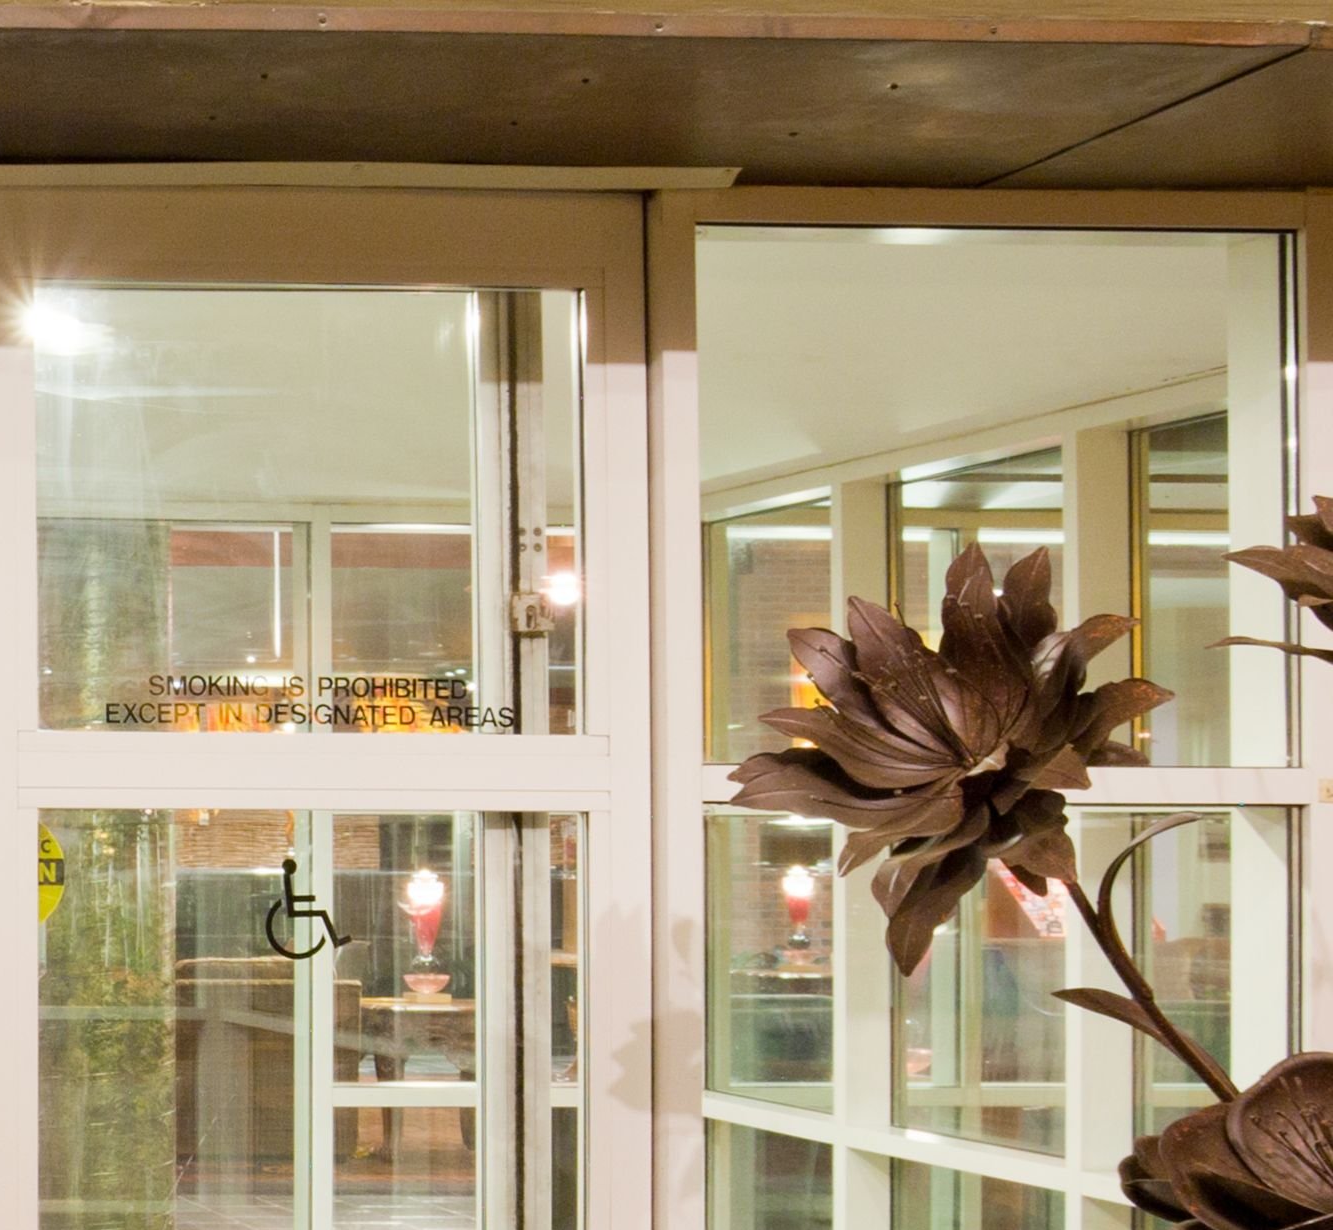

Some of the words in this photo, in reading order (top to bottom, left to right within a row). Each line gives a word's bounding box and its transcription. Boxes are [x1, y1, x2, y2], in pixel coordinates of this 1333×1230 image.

[148, 675, 269, 697] SMOKING
[282, 676, 304, 697] IS
[318, 676, 467, 700] PROHIBITED
[105, 703, 206, 724] EXCEPT
[218, 704, 242, 725] IN
[256, 703, 416, 726] DESIGNATED
[429, 706, 515, 728] AREAS
